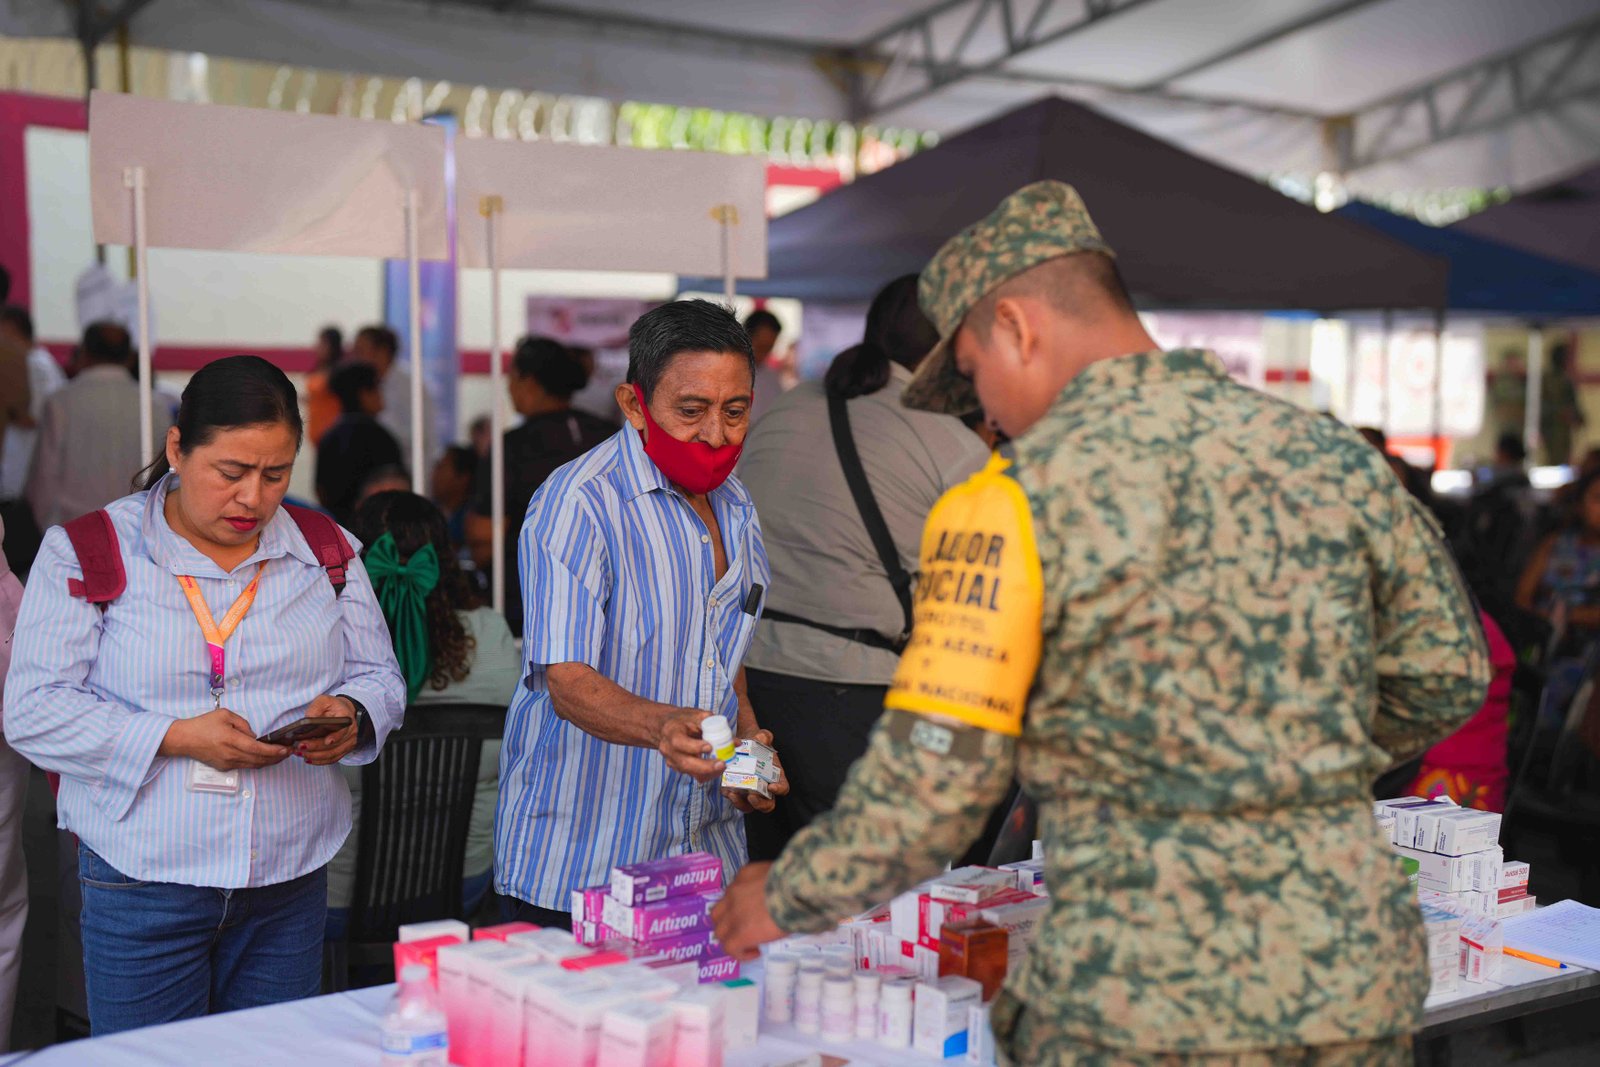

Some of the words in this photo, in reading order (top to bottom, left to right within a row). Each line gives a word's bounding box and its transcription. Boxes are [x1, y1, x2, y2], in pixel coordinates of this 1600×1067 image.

[927, 531, 1005, 568] ABOR
[915, 571, 1001, 611] OCIAL
[674, 867, 719, 886] Artizon
[649, 912, 699, 935] Artizon
[700, 958, 738, 979] Artizo
